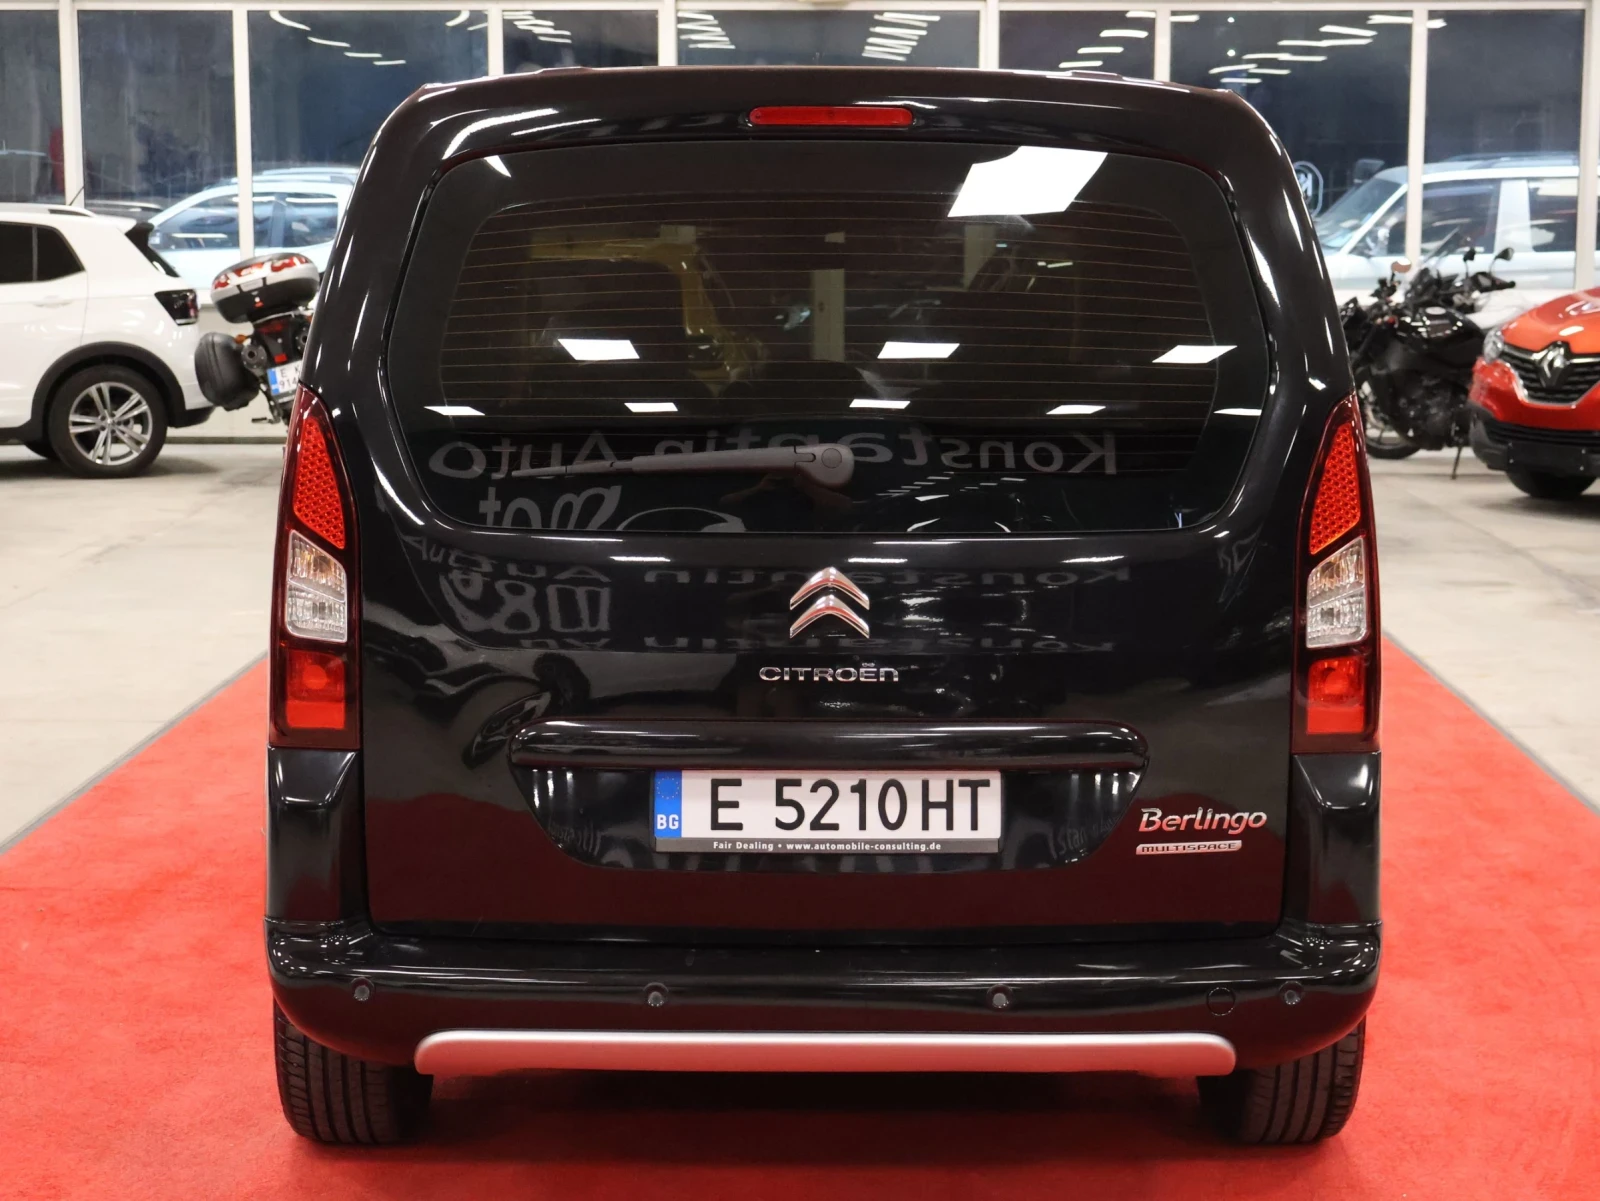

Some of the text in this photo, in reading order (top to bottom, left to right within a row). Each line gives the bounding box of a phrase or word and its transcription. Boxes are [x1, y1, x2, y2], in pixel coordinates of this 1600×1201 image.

[710, 778, 744, 831] E
[657, 814, 679, 830] BG
[1138, 806, 1268, 835] Berlingo
[713, 841, 942, 852] Fair Dealing www.automobile-consulting.de
[1141, 842, 1238, 853] MULTISPACE
